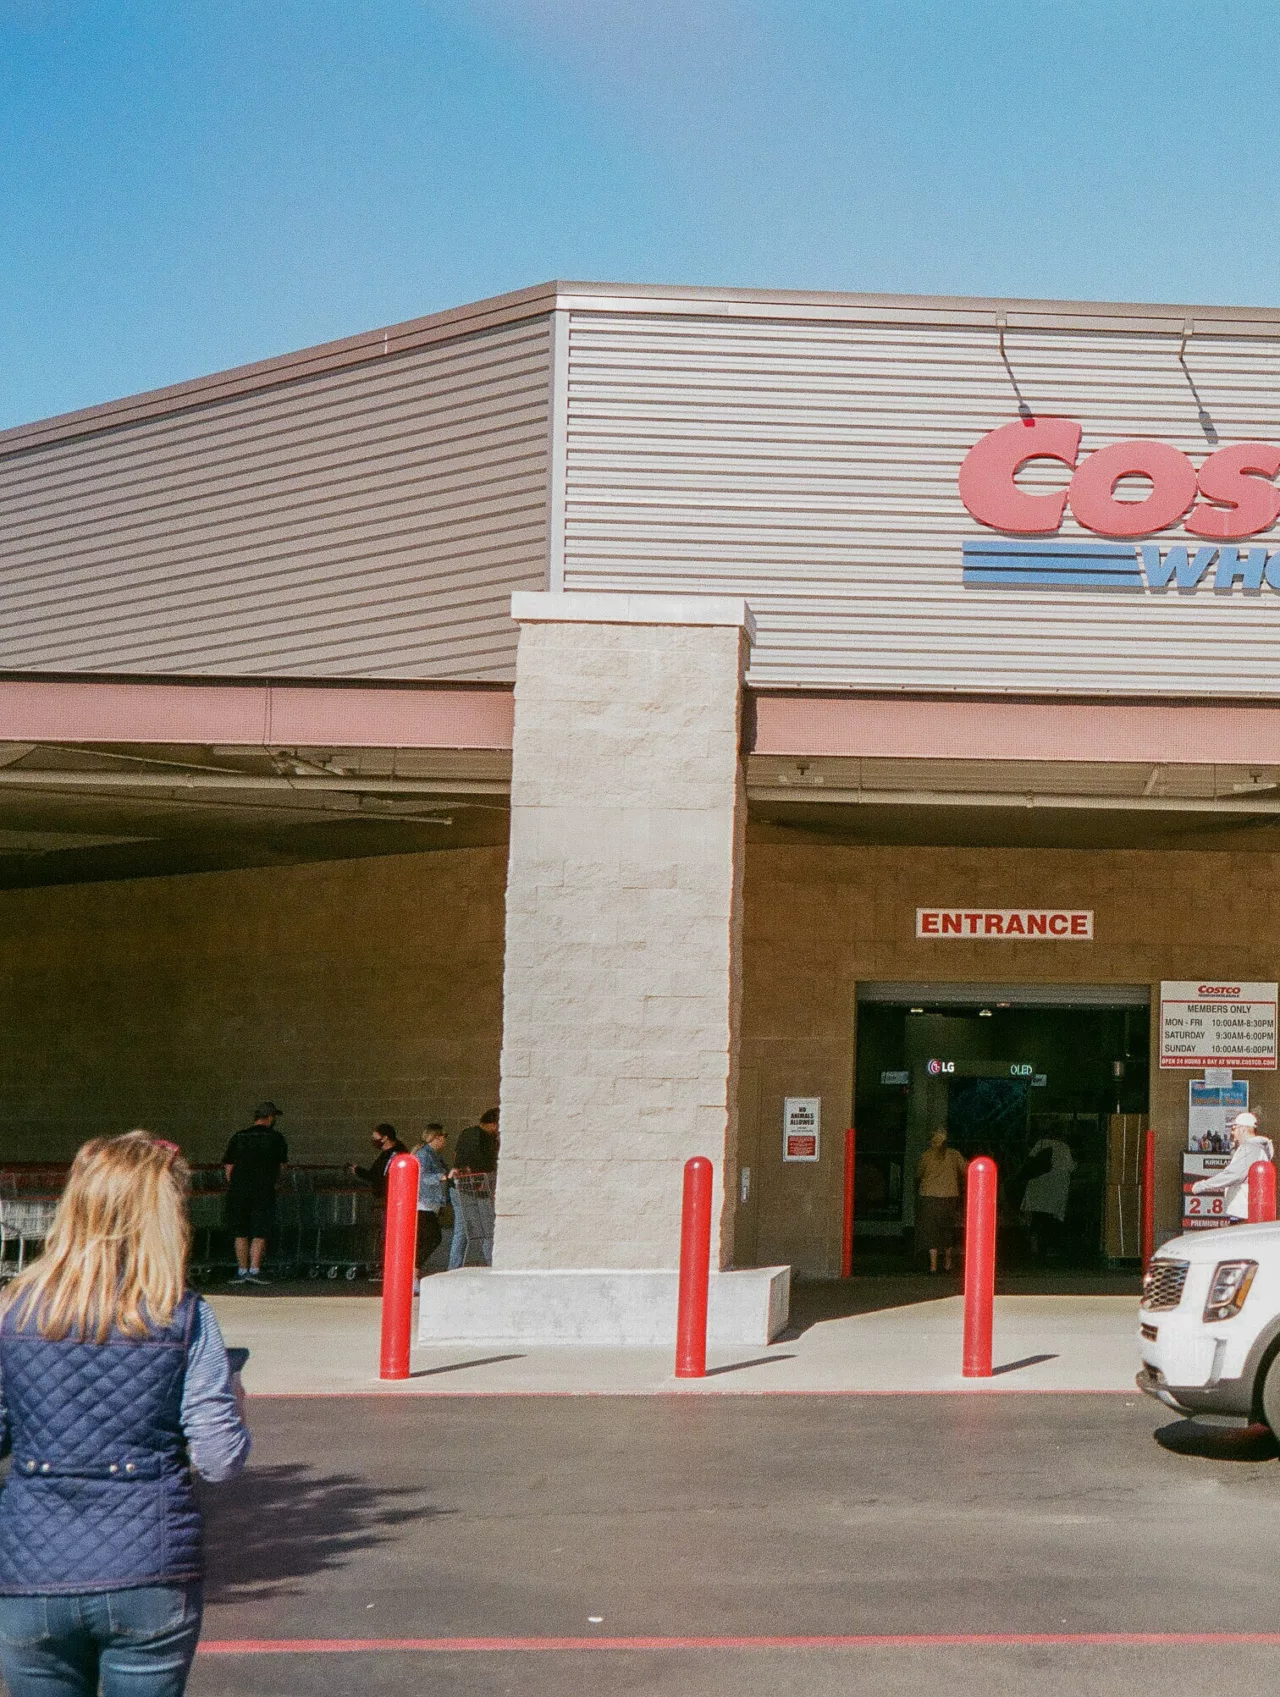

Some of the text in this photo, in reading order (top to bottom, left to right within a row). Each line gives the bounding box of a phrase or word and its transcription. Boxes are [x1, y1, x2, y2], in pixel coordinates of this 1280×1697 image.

[921, 913, 1088, 935] ENTRANCE
[1198, 985, 1241, 994] COSTCO
[1187, 1005, 1251, 1014] MEMBERS ONLY
[1190, 1019, 1203, 1027] FRI
[1212, 1019, 1274, 1028] 10:00AM-8:30PM
[1164, 1031, 1274, 1040] SATURDAY 9:30AM-6:00PM
[1164, 1044, 1196, 1053] SUNDAY
[942, 1062, 955, 1072] LG
[1010, 1064, 1032, 1075] OLED
